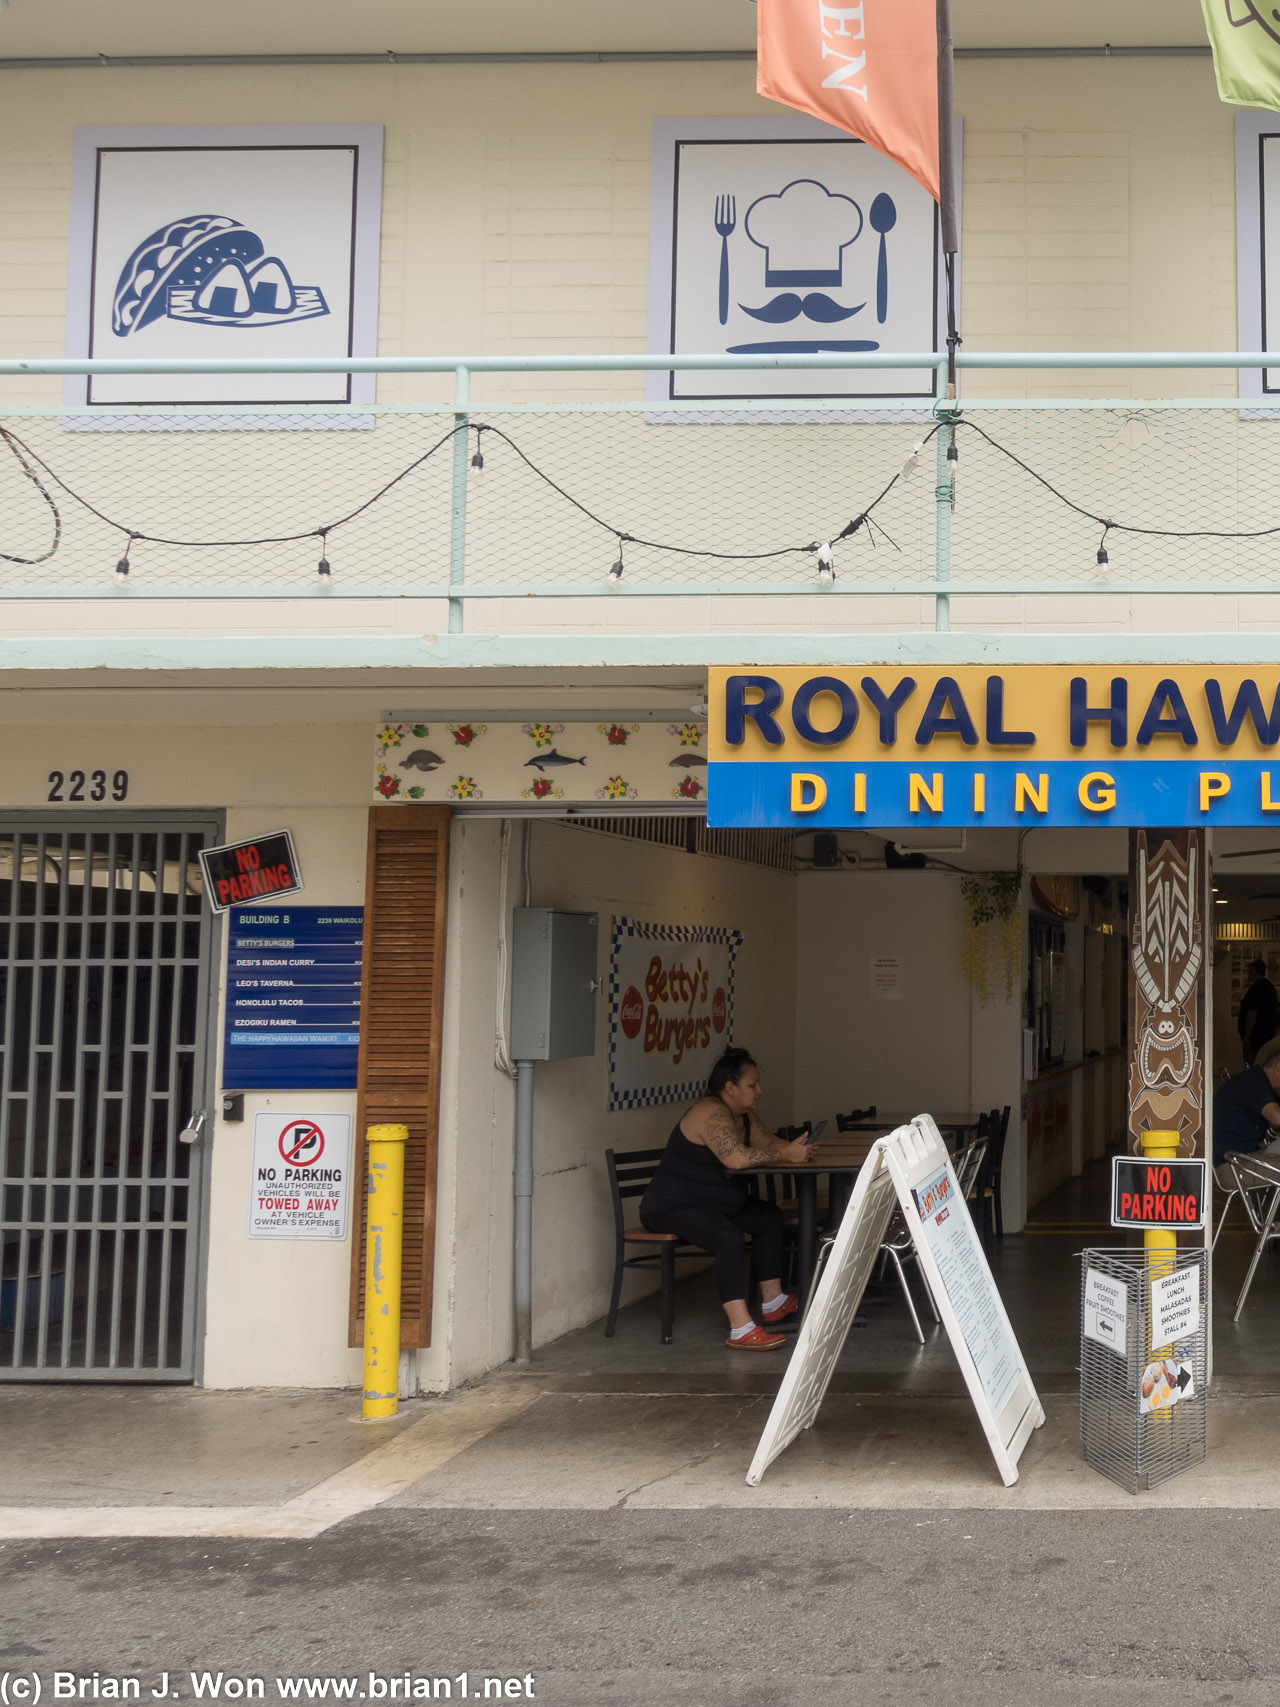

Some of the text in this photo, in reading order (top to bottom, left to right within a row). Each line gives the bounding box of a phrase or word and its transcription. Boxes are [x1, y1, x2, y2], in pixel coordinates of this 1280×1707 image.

[725, 675, 1036, 746] ROYAL
[47, 770, 128, 801] 2239
[790, 772, 1117, 813] DINING
[235, 845, 260, 872] NO
[216, 864, 291, 904] PARKING
[239, 915, 279, 924] BUILDING
[283, 915, 290, 924] B
[645, 956, 710, 1016] Betty's
[233, 1034, 247, 1042] THE
[248, 1034, 271, 1042] HAPPY
[272, 1034, 307, 1042] HAWAIIAN
[644, 1003, 712, 1066] Burgers
[258, 1168, 342, 1182] NO PARKING
[1146, 1166, 1171, 1193] NO
[265, 1182, 333, 1190] UNAUTHORIZED
[258, 1198, 339, 1211] TOWED AWAY
[1121, 1193, 1197, 1221] PARKING
[254, 1218, 341, 1227] OWNER'S EXPENSE
[286, 1211, 325, 1219] VEHICLE
[1161, 1272, 1191, 1289] BREAKFAST
[1093, 1281, 1119, 1298] BREAKFAST
[1166, 1286, 1185, 1299] LUNCH
[1097, 1293, 1115, 1307] COFFEE
[1160, 1295, 1192, 1313] MALASADAS
[1086, 1298, 1125, 1322] FRUIT SMOOTHIES
[1161, 1307, 1191, 1325] SMOOTHIES
[1164, 1324, 1179, 1336] STALL
